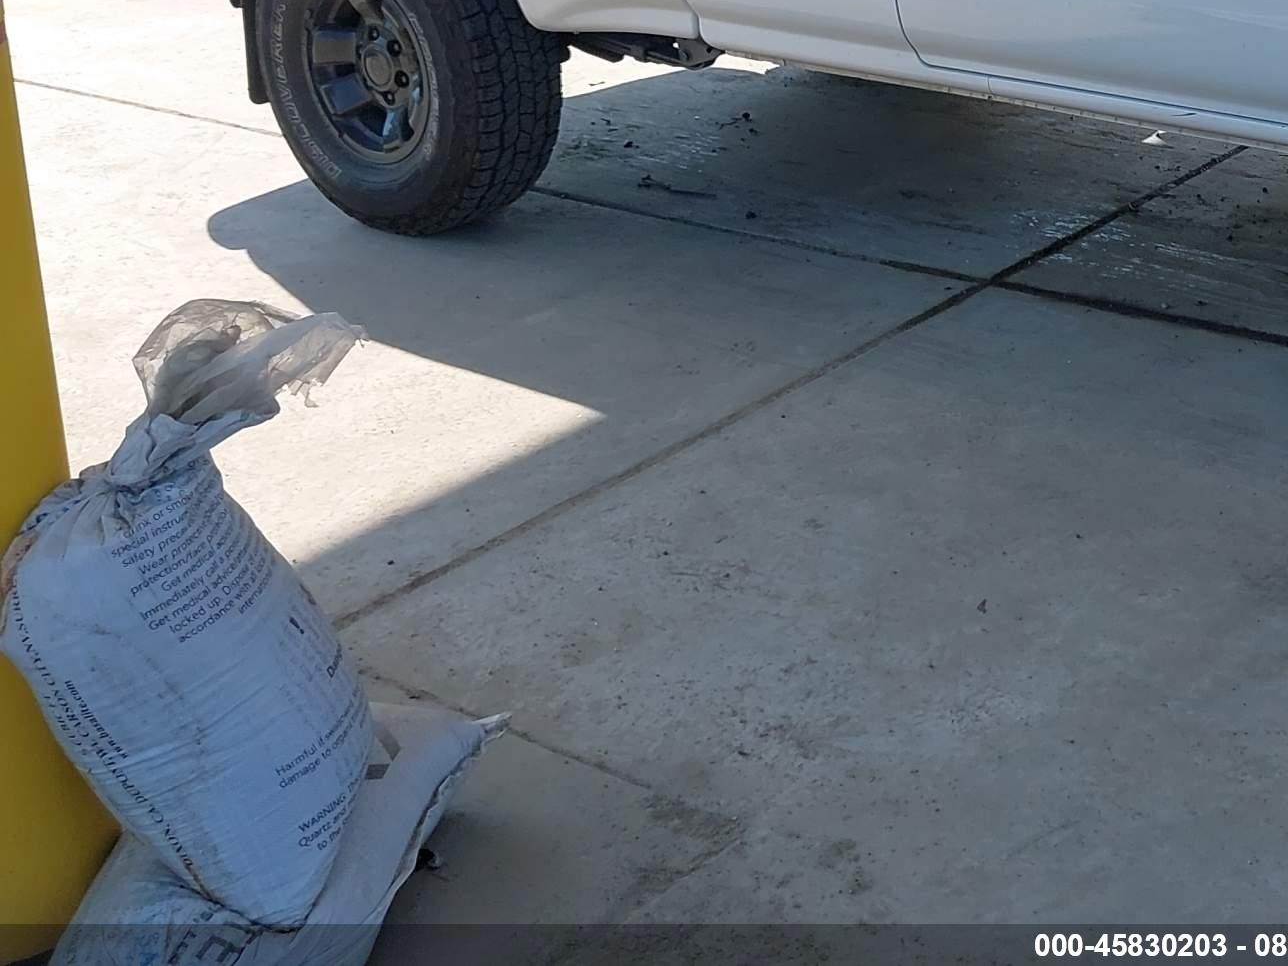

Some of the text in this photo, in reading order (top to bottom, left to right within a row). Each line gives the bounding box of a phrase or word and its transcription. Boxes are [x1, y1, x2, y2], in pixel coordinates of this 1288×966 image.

[111, 534, 150, 558] special
[122, 546, 155, 568] Safety
[138, 554, 168, 576] Wear
[160, 572, 182, 592] Get
[140, 575, 205, 621] Immediately
[148, 615, 171, 632] Get
[172, 586, 211, 620] medical
[170, 607, 206, 634] locked
[179, 598, 235, 643] accordance
[275, 741, 317, 776] Harmful
[279, 759, 321, 789] damage
[298, 820, 331, 849] Quartz
